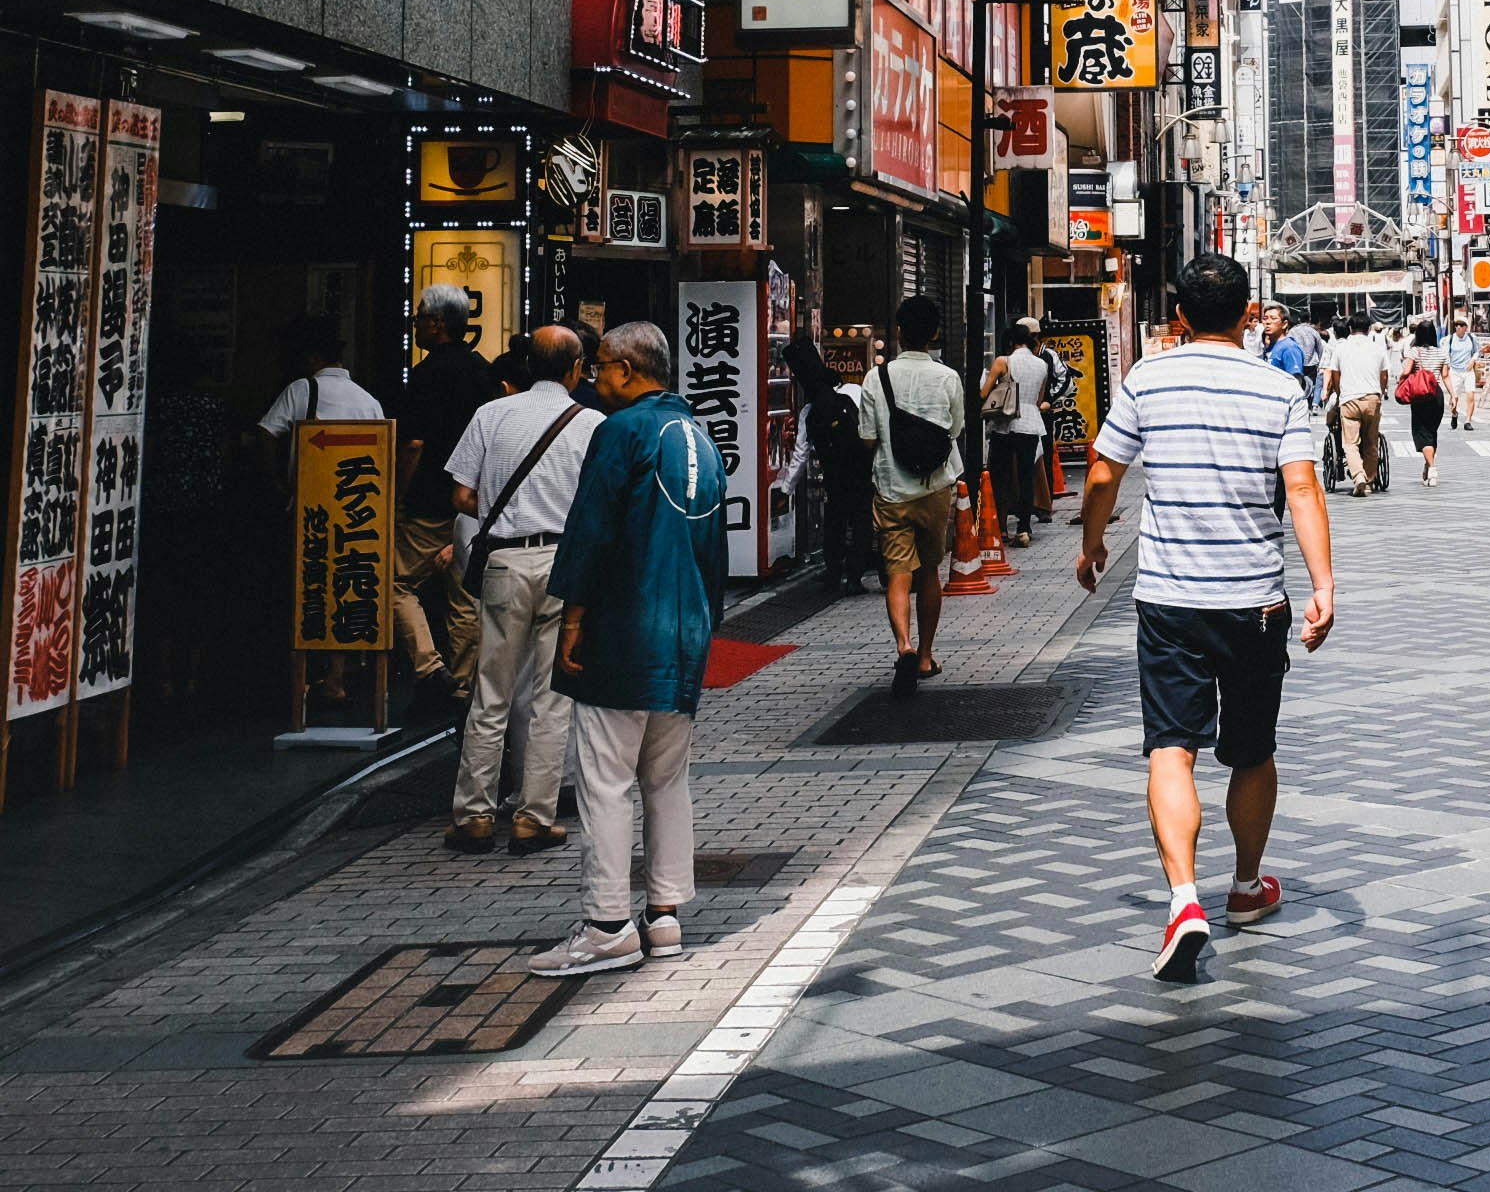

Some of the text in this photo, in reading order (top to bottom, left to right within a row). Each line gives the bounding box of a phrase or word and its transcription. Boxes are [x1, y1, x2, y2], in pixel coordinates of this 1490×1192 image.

[873, 16, 934, 138] カラオケ
[998, 98, 1049, 156] 酒
[685, 301, 752, 530] 演芸場口
[332, 455, 380, 644] チケット売場
